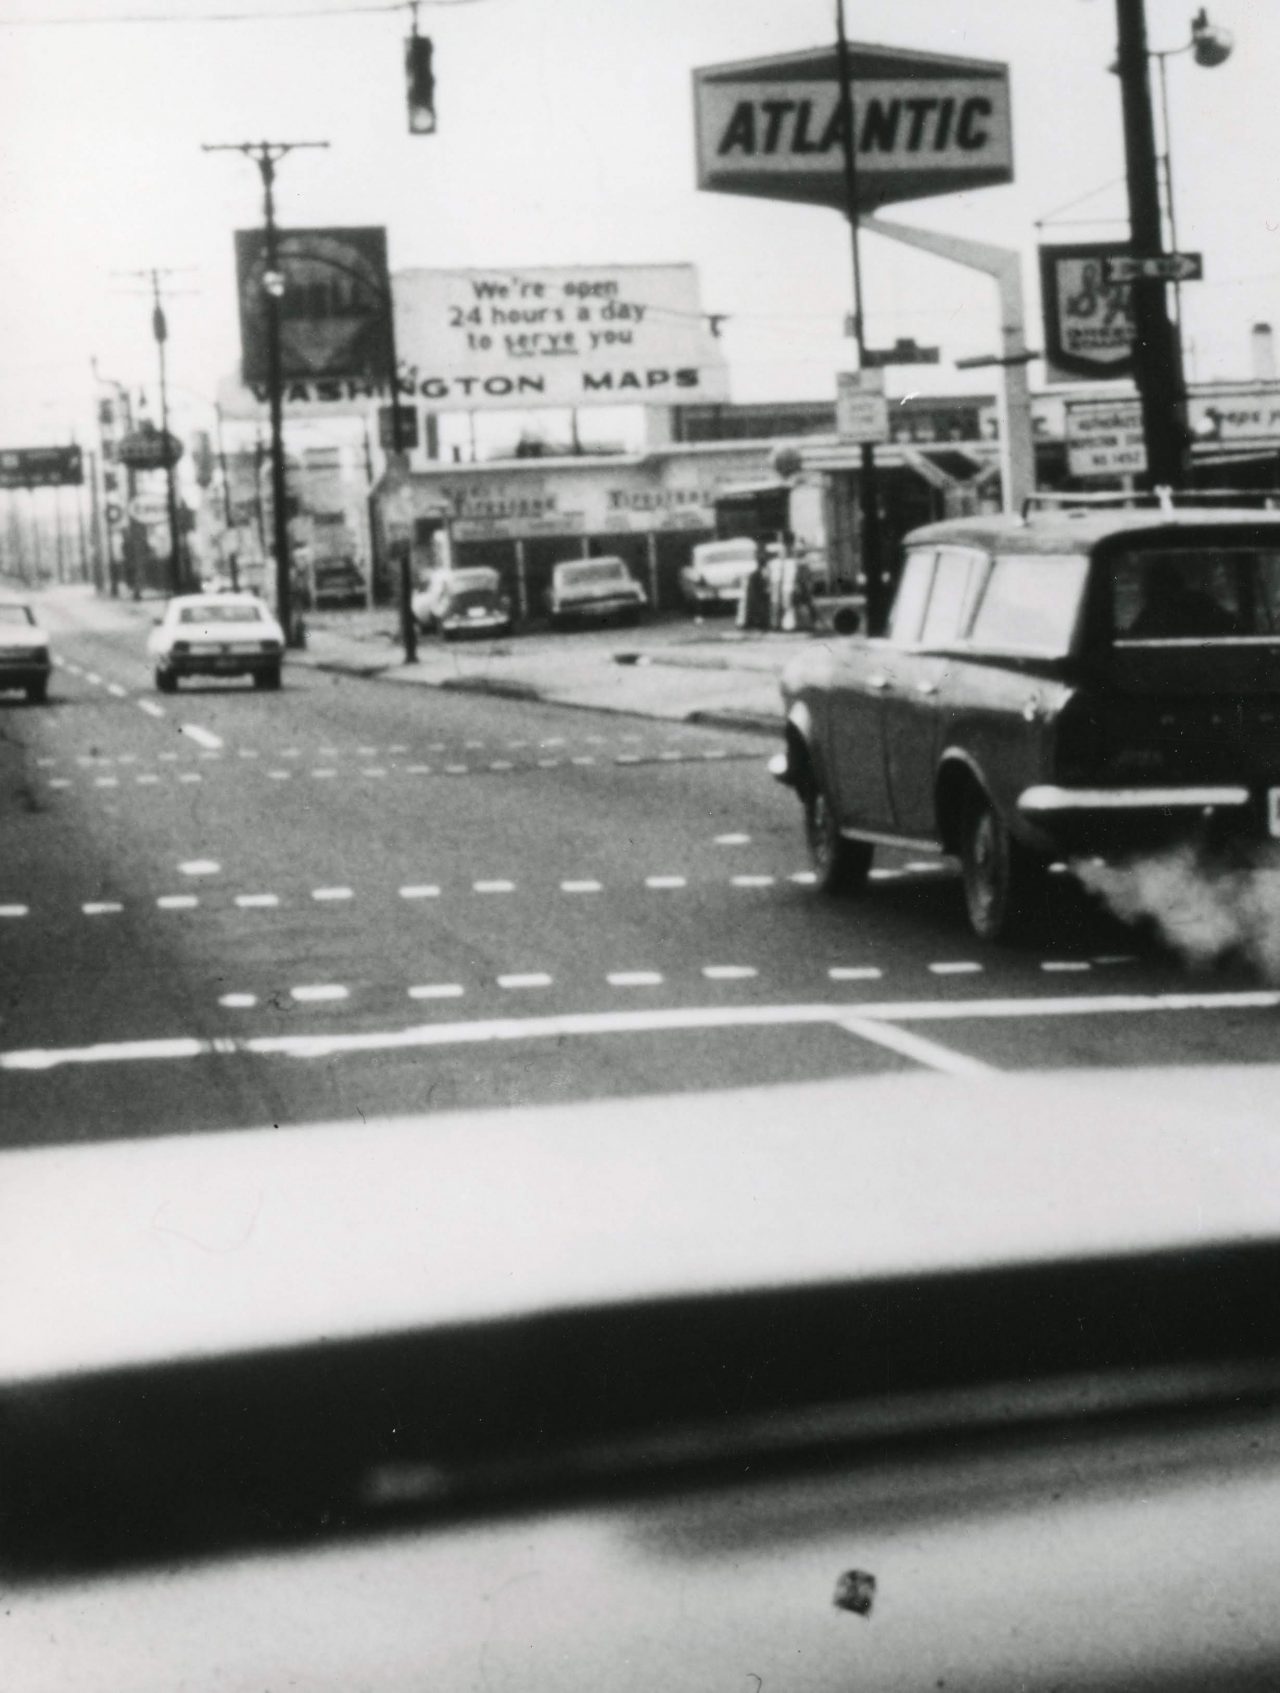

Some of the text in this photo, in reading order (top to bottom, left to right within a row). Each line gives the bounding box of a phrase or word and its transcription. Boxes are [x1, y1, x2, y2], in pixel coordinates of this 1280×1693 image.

[717, 97, 992, 155] ATLANTIC
[472, 276, 619, 299] We're open
[449, 299, 647, 327] 24 hours a day
[466, 328, 633, 351] to serve you
[582, 368, 699, 391] MAPS
